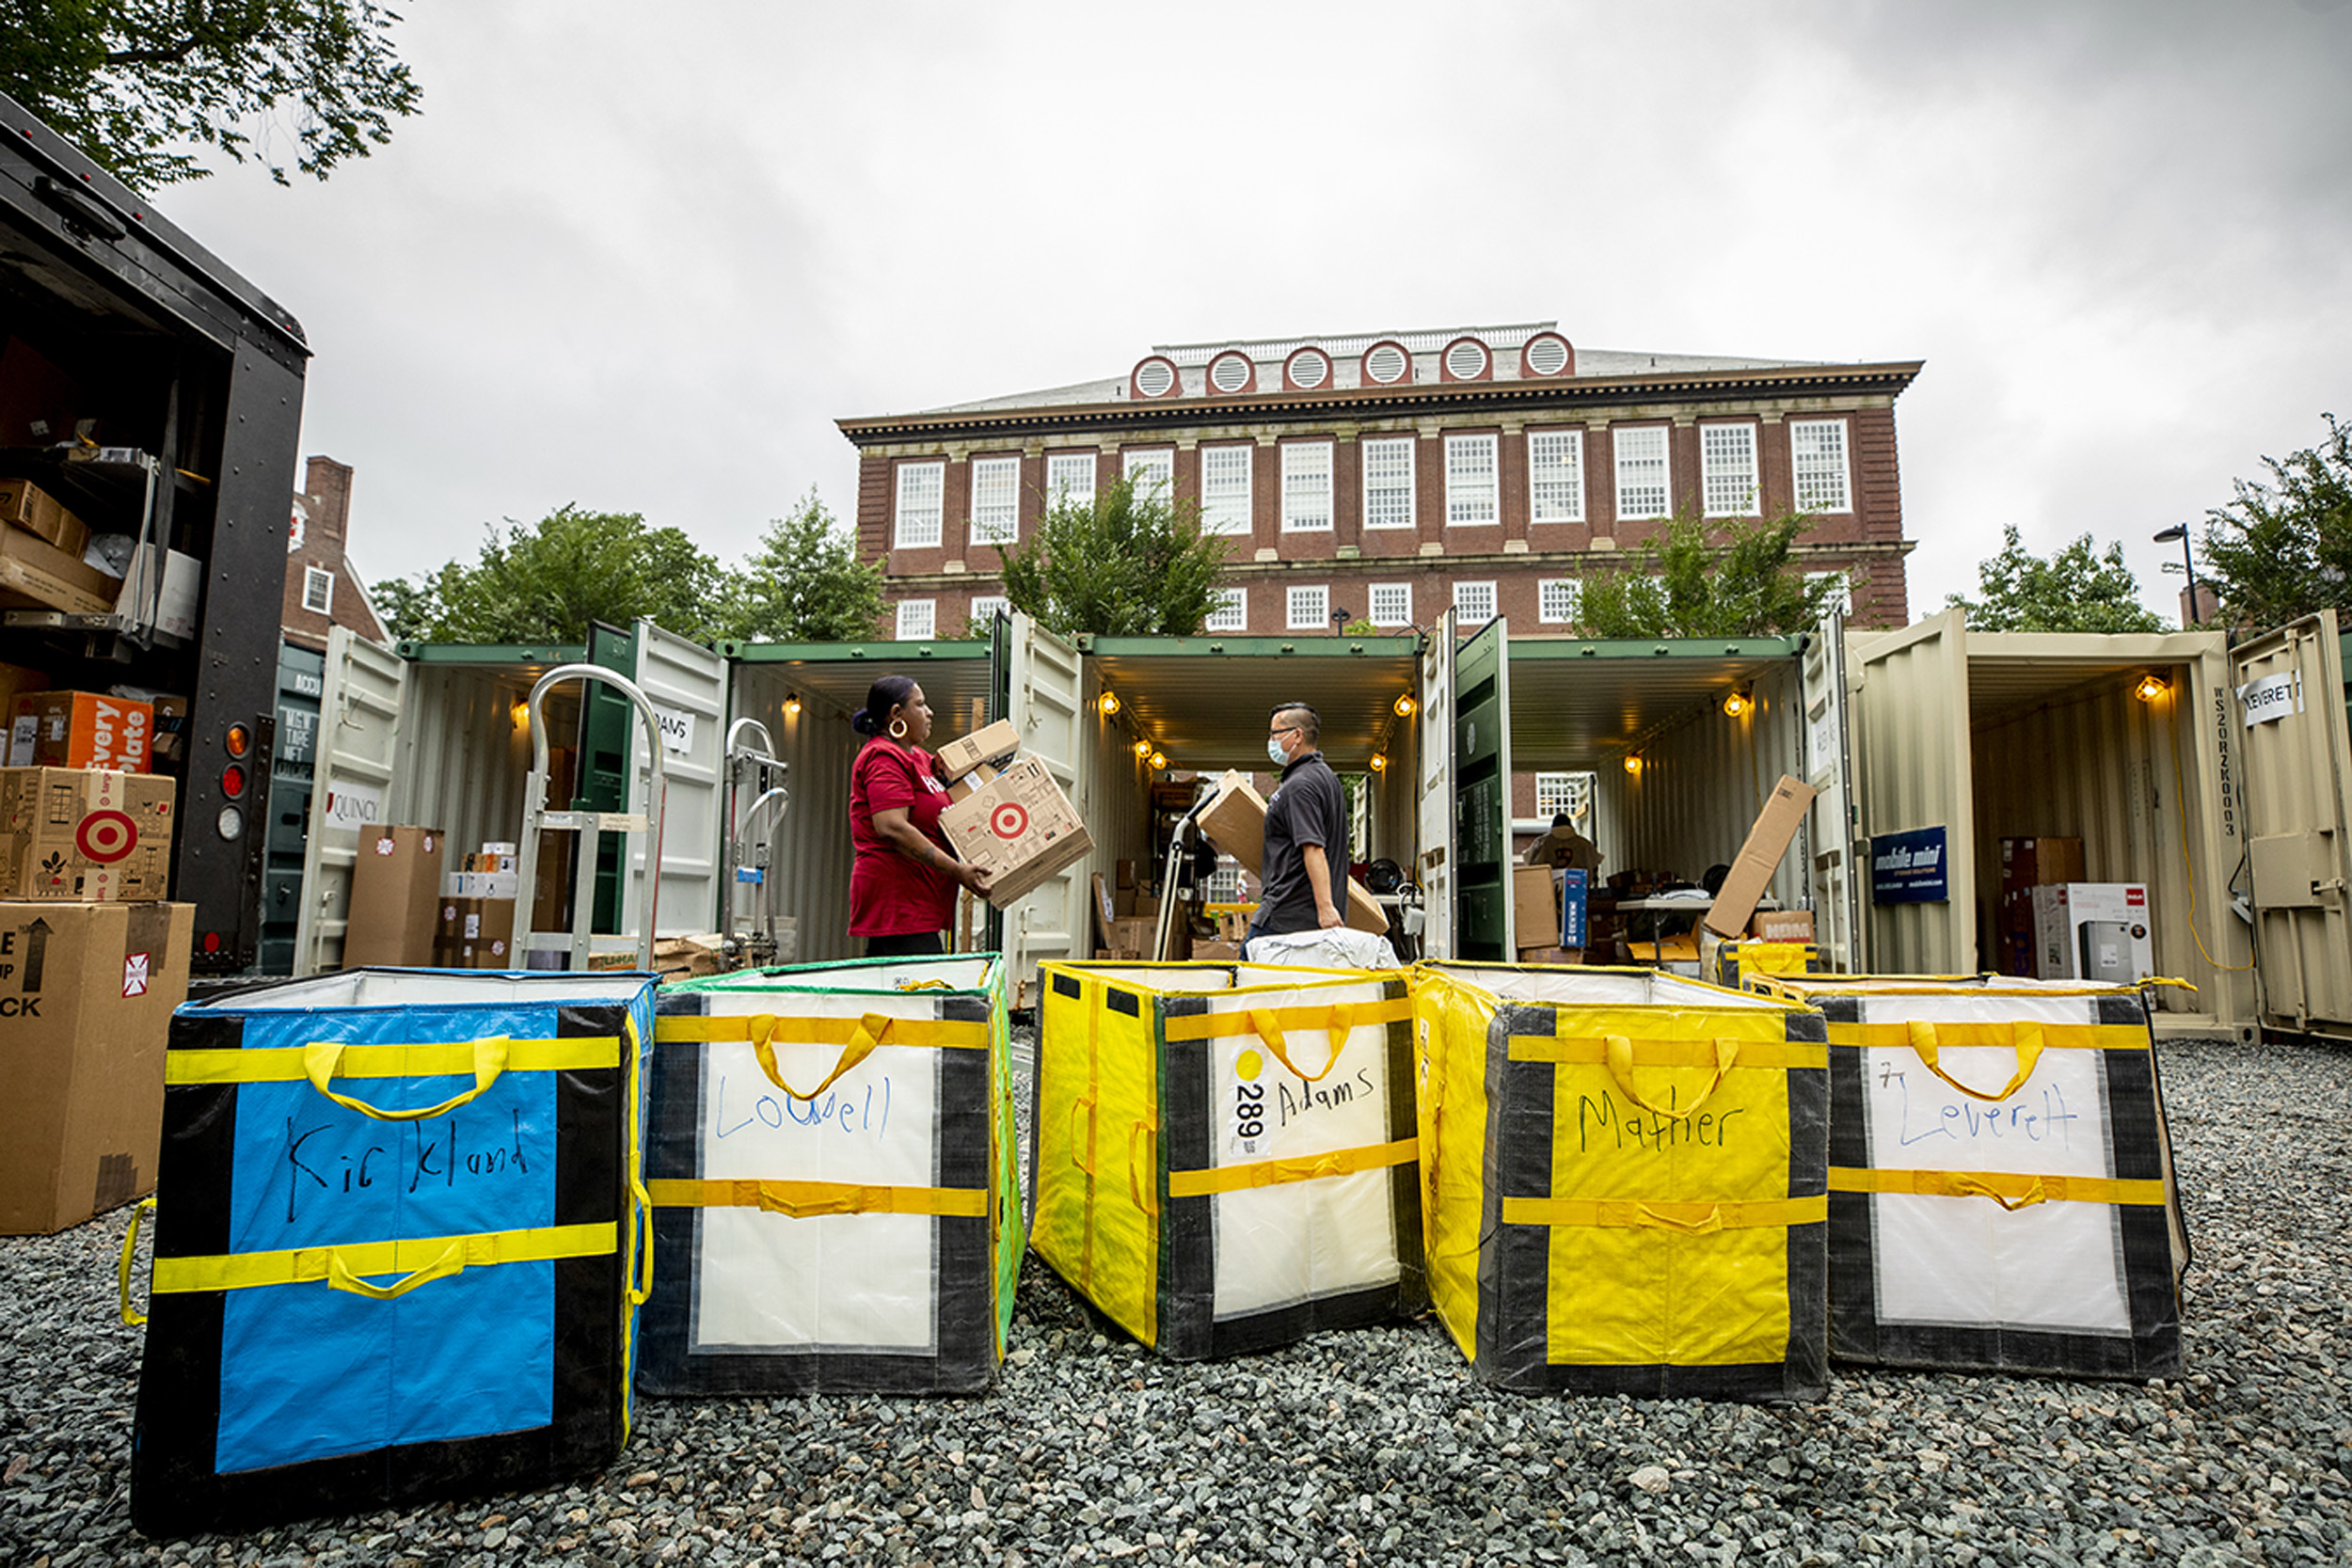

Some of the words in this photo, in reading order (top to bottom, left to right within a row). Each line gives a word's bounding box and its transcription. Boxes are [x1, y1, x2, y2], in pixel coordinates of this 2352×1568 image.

[334, 794, 380, 822] QUINCY
[1875, 846, 1912, 871] mobile
[1913, 844, 1942, 867] mini
[1236, 1083, 1264, 1138] 289
[1278, 1067, 1375, 1128] Adams
[1579, 1085, 1744, 1153] Mather
[1898, 1074, 2078, 1152] Leverett
[285, 1107, 530, 1224] Kirkland
